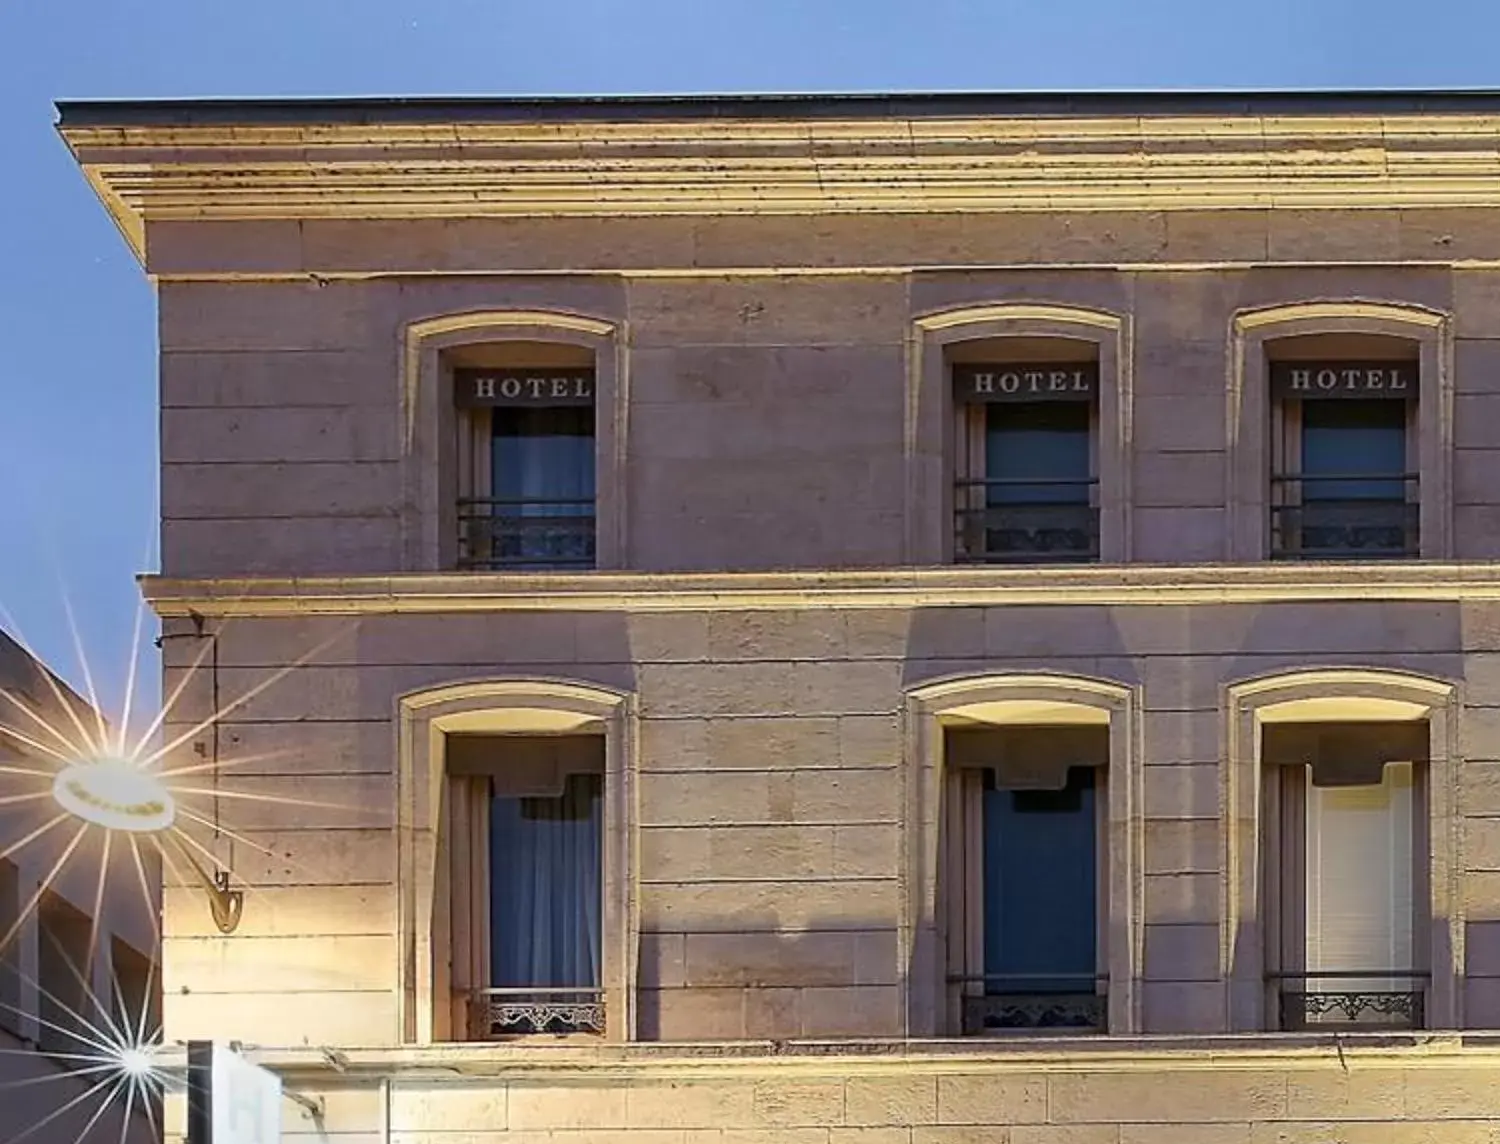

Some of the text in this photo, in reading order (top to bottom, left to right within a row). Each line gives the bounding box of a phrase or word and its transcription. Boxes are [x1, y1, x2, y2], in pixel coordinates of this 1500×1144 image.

[477, 378, 592, 398] HOTEL
[975, 372, 1089, 393] HOTEL
[1291, 369, 1406, 390] HOTEL
